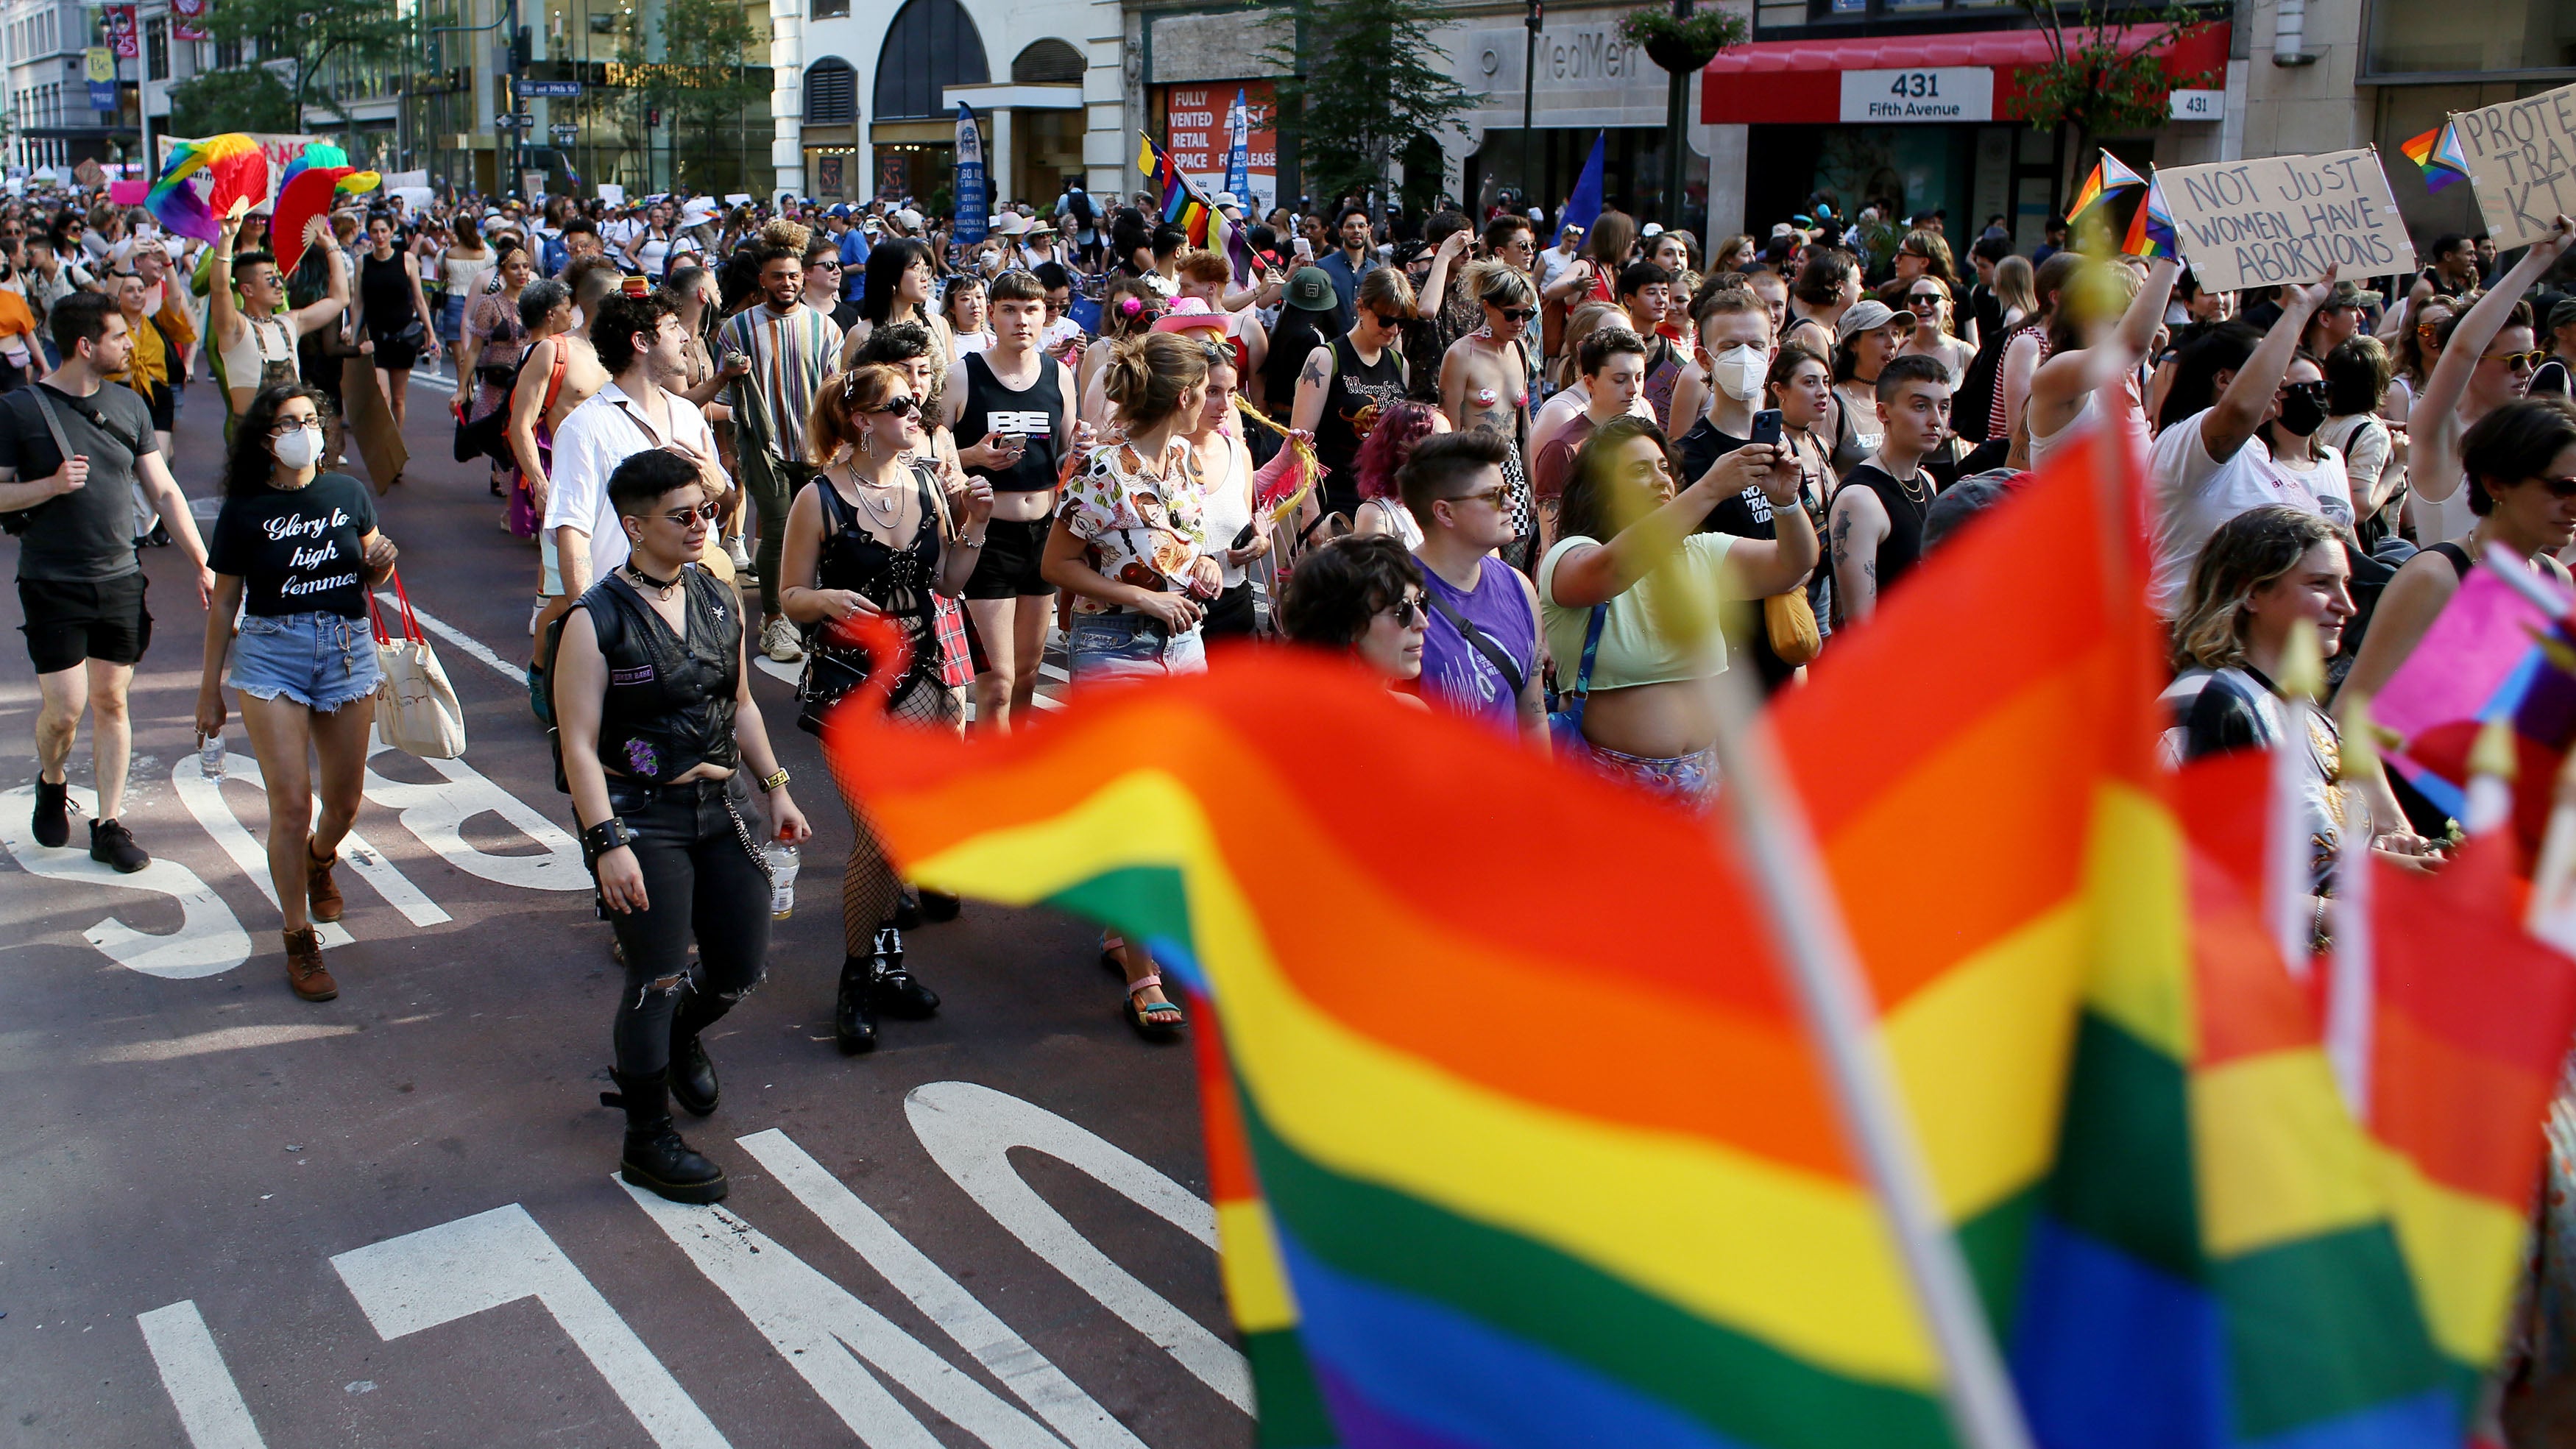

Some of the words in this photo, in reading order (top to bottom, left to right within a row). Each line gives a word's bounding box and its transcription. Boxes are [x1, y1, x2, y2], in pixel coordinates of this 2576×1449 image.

[1533, 32, 1637, 80] MedMen
[1890, 72, 1939, 97] 431
[1175, 91, 1208, 107] FULLY
[1869, 102, 1901, 116] Fifth
[1905, 102, 1961, 116] Avenue
[2186, 96, 2207, 113] 431
[1170, 112, 1214, 127] VENTED
[1172, 132, 1210, 148] RETAIL
[1174, 152, 1209, 169] SPACE
[2184, 166, 2260, 212] NOT
[2279, 156, 2360, 202] JUST
[2504, 165, 2576, 238] KI
[2184, 210, 2293, 247] WOMEN
[2301, 196, 2384, 236] HAVE
[2235, 233, 2394, 285] ABORTIONS
[987, 411, 1050, 433] BE
[263, 513, 329, 541] Glory
[330, 507, 350, 528] to
[289, 539, 339, 571] high
[280, 572, 358, 598] femmes
[634, 669, 651, 679] BABE
